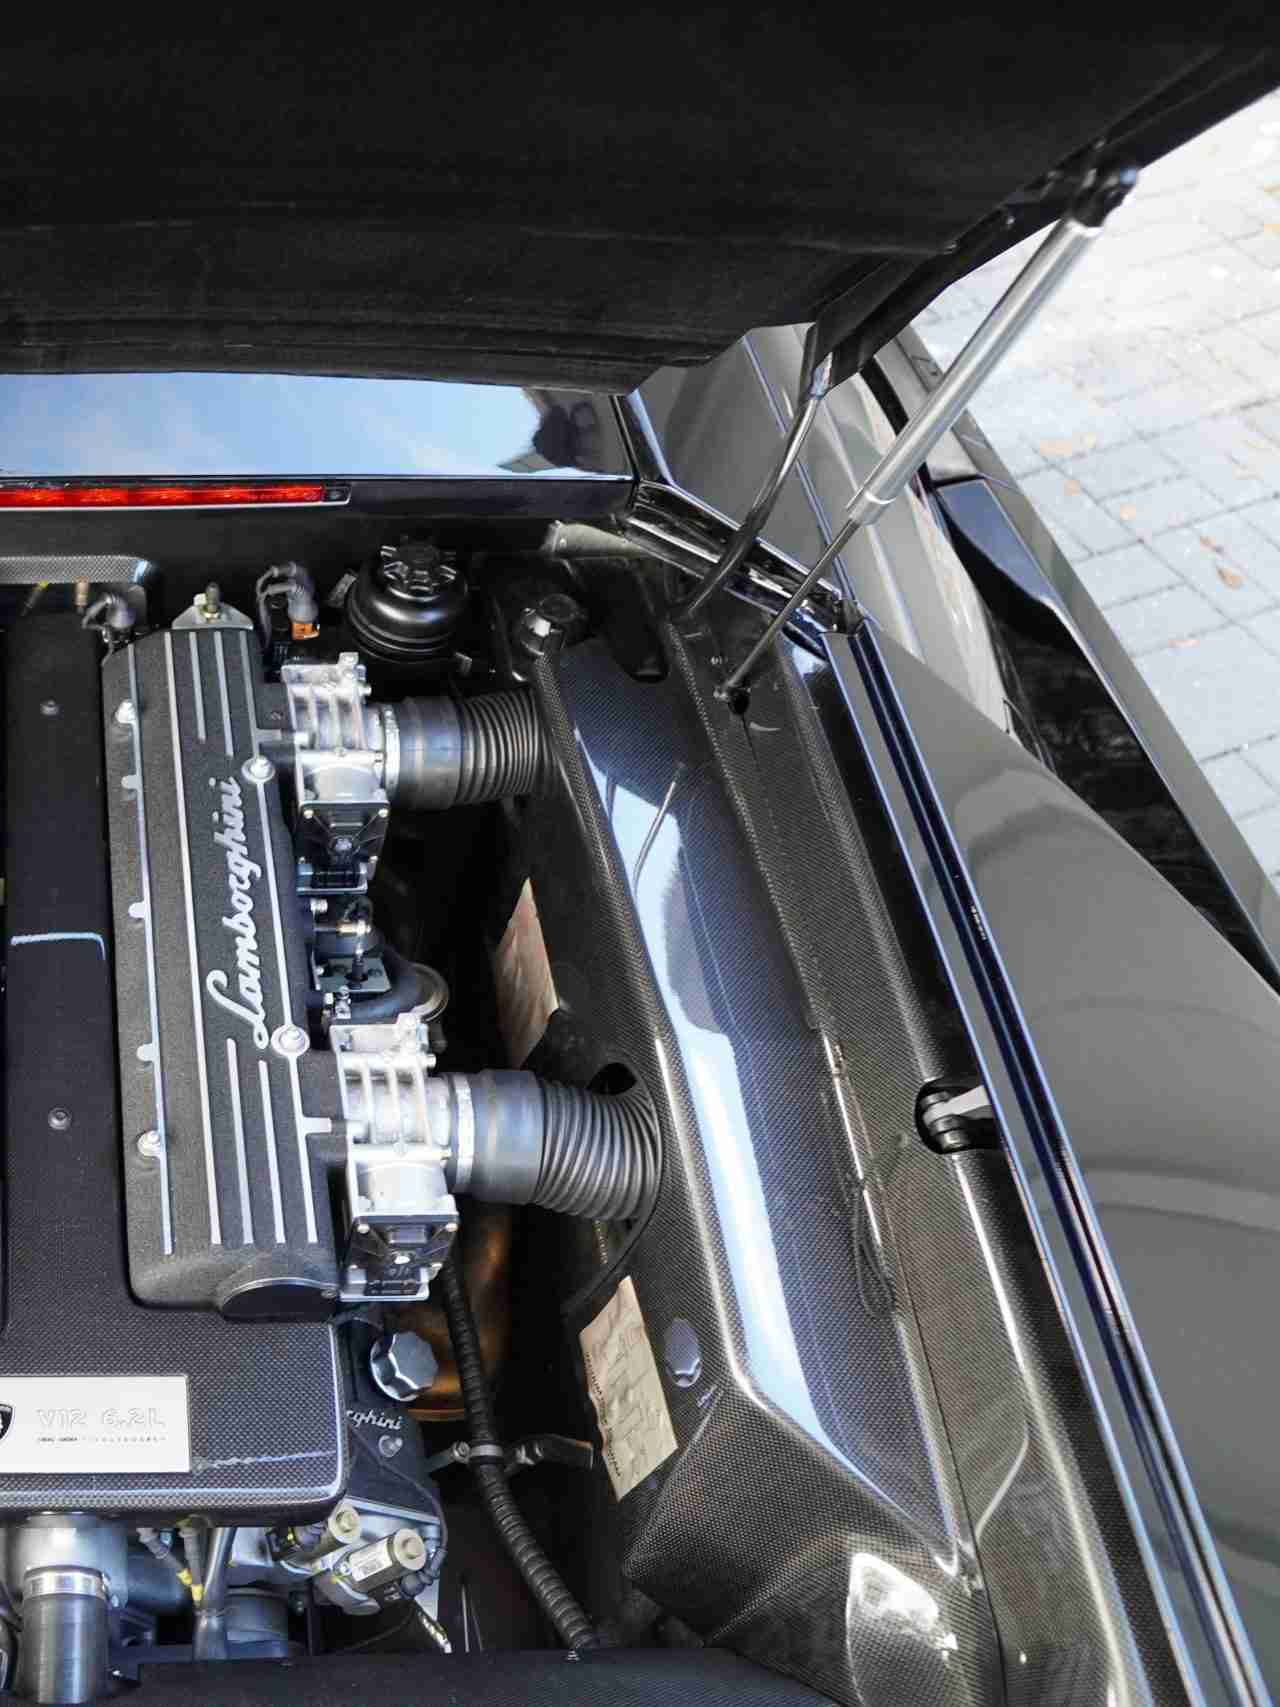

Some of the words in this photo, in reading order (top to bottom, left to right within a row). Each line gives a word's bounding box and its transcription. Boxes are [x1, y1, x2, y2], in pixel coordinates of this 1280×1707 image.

[206, 776, 269, 1050] Lamborghini
[36, 1408, 87, 1427] V12
[346, 1410, 402, 1430] rghini
